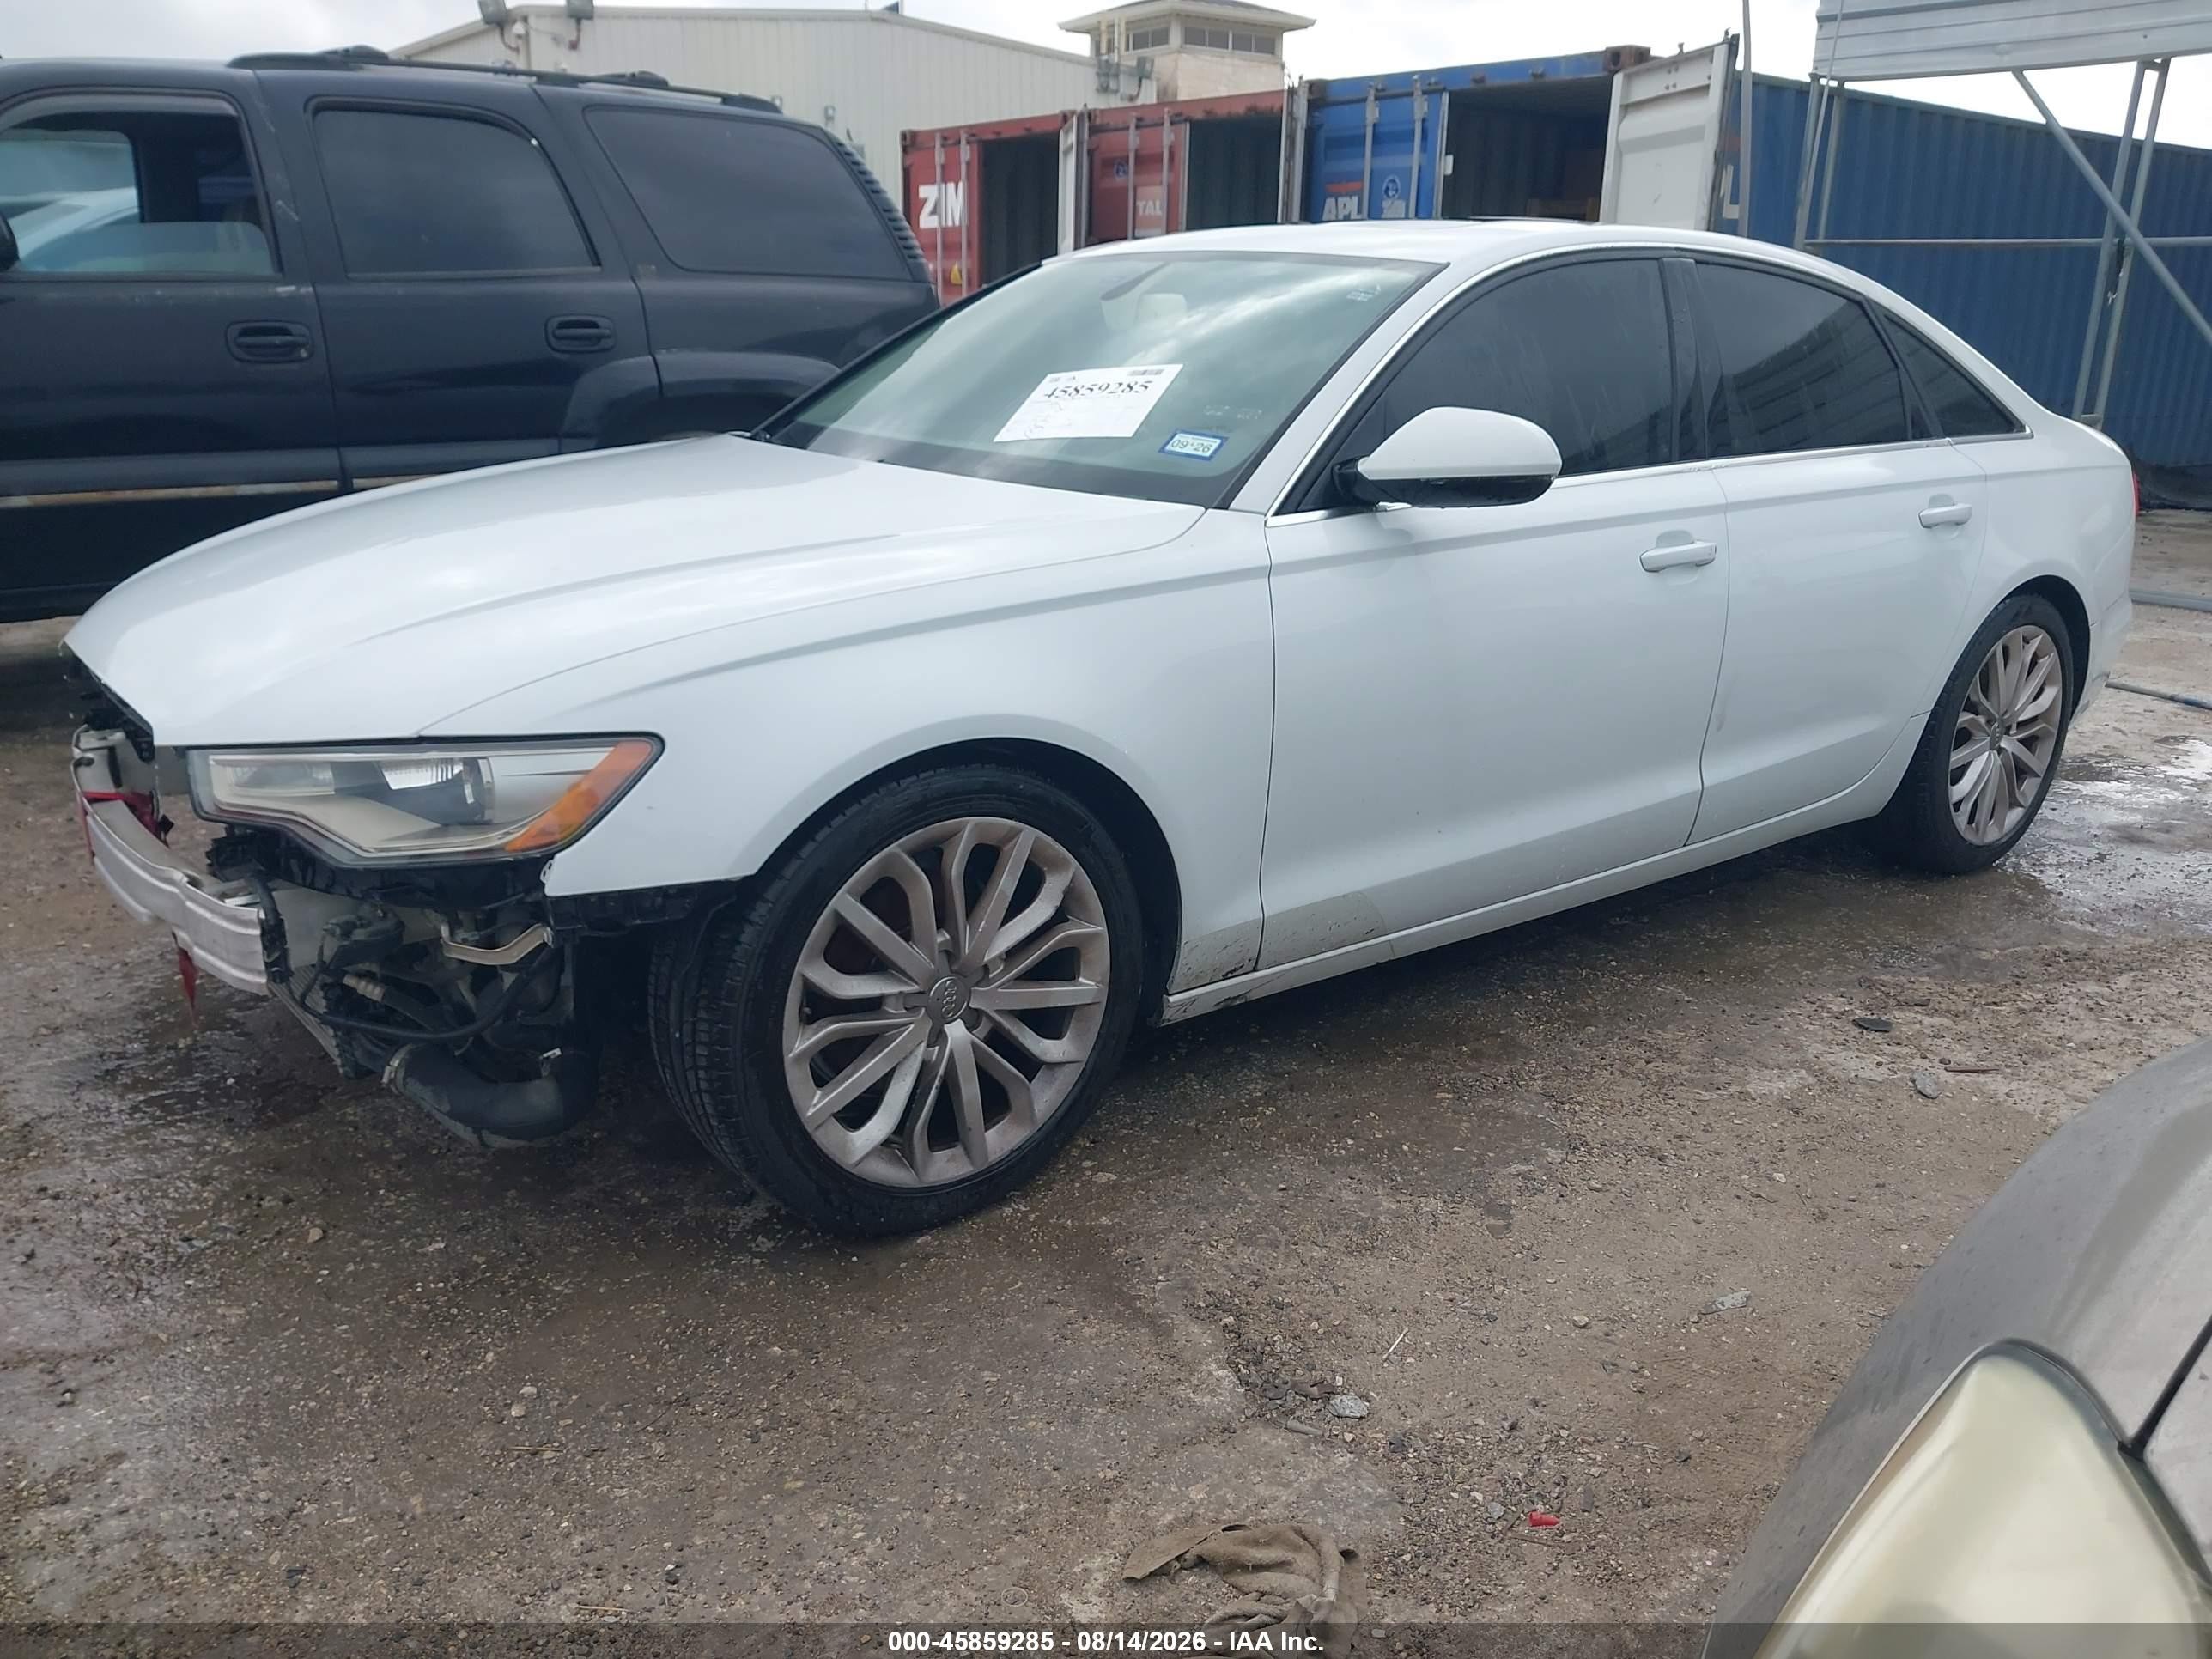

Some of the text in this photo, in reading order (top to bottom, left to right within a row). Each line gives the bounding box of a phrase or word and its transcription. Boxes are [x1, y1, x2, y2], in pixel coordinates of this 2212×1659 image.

[918, 180, 968, 229] ZIM
[1136, 199, 1163, 216] TAL
[1322, 195, 1364, 221] APL
[1044, 380, 1153, 398] 45859285
